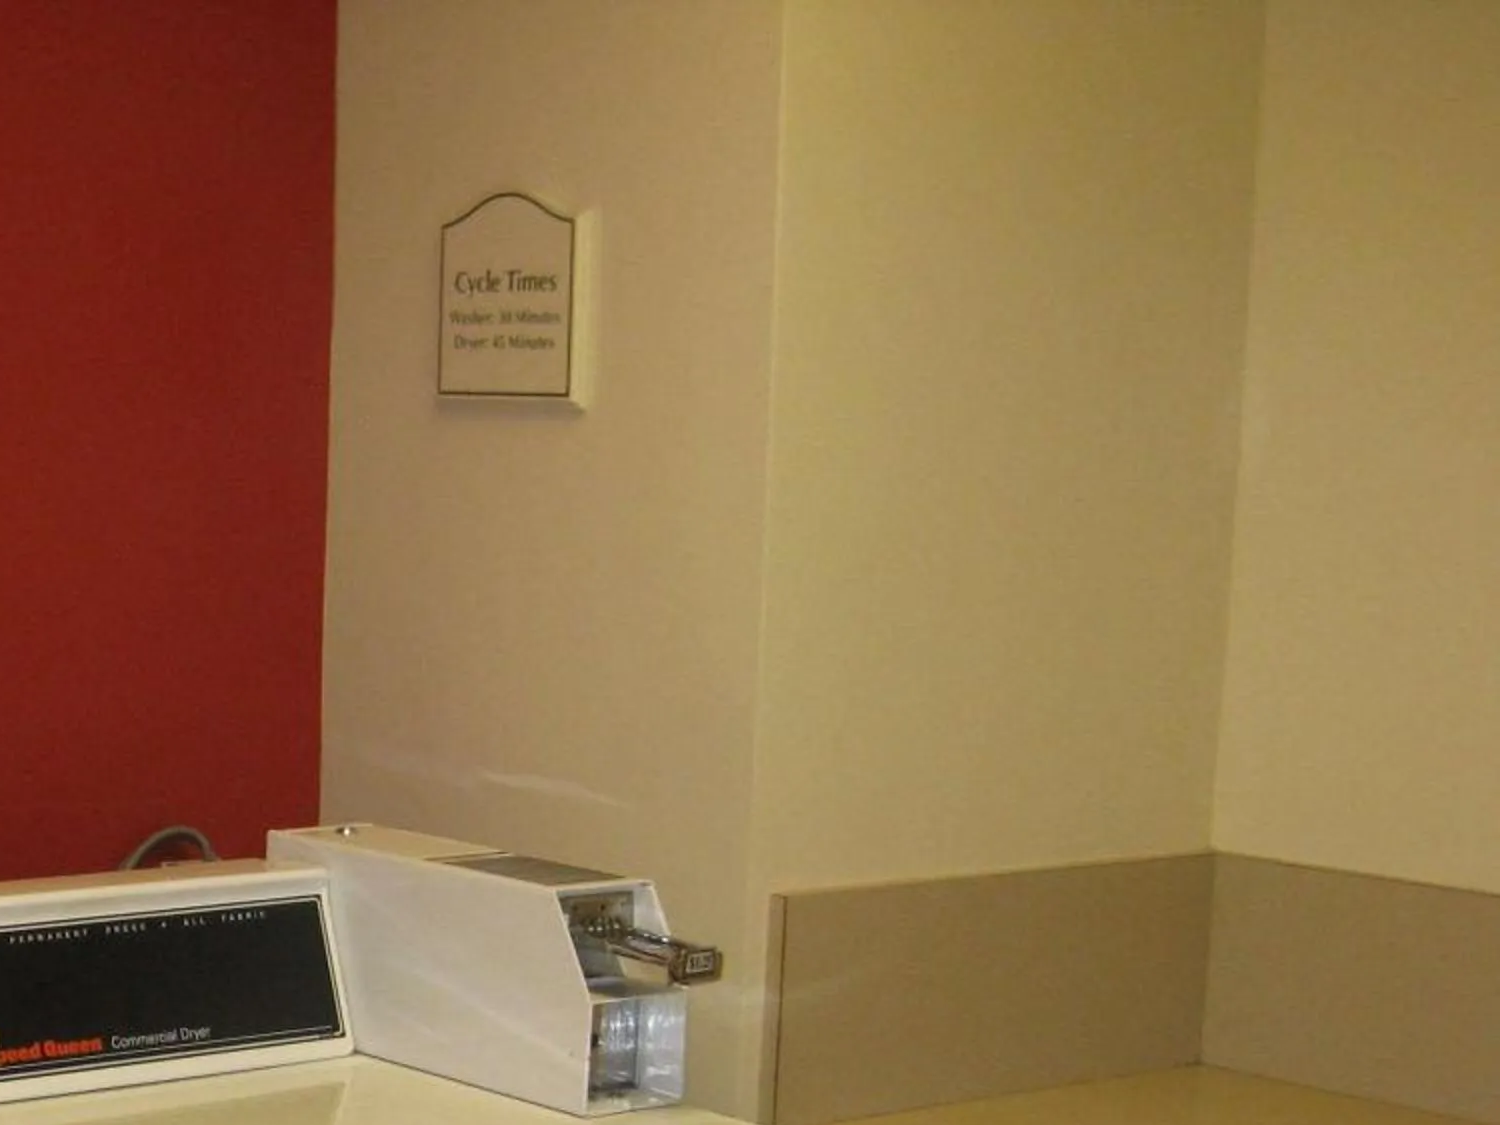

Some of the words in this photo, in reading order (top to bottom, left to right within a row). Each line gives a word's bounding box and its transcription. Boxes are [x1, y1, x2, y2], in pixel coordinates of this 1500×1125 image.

[454, 268, 501, 298] Cycle
[504, 268, 558, 293] Times
[8, 928, 89, 945] PERMANENT
[104, 922, 148, 936] PRESS
[183, 916, 206, 928] ALL
[220, 910, 268, 923] FABRIC
[42, 1037, 103, 1058] Queen
[111, 1027, 178, 1049] Commercial
[180, 1026, 211, 1042] Dryer
